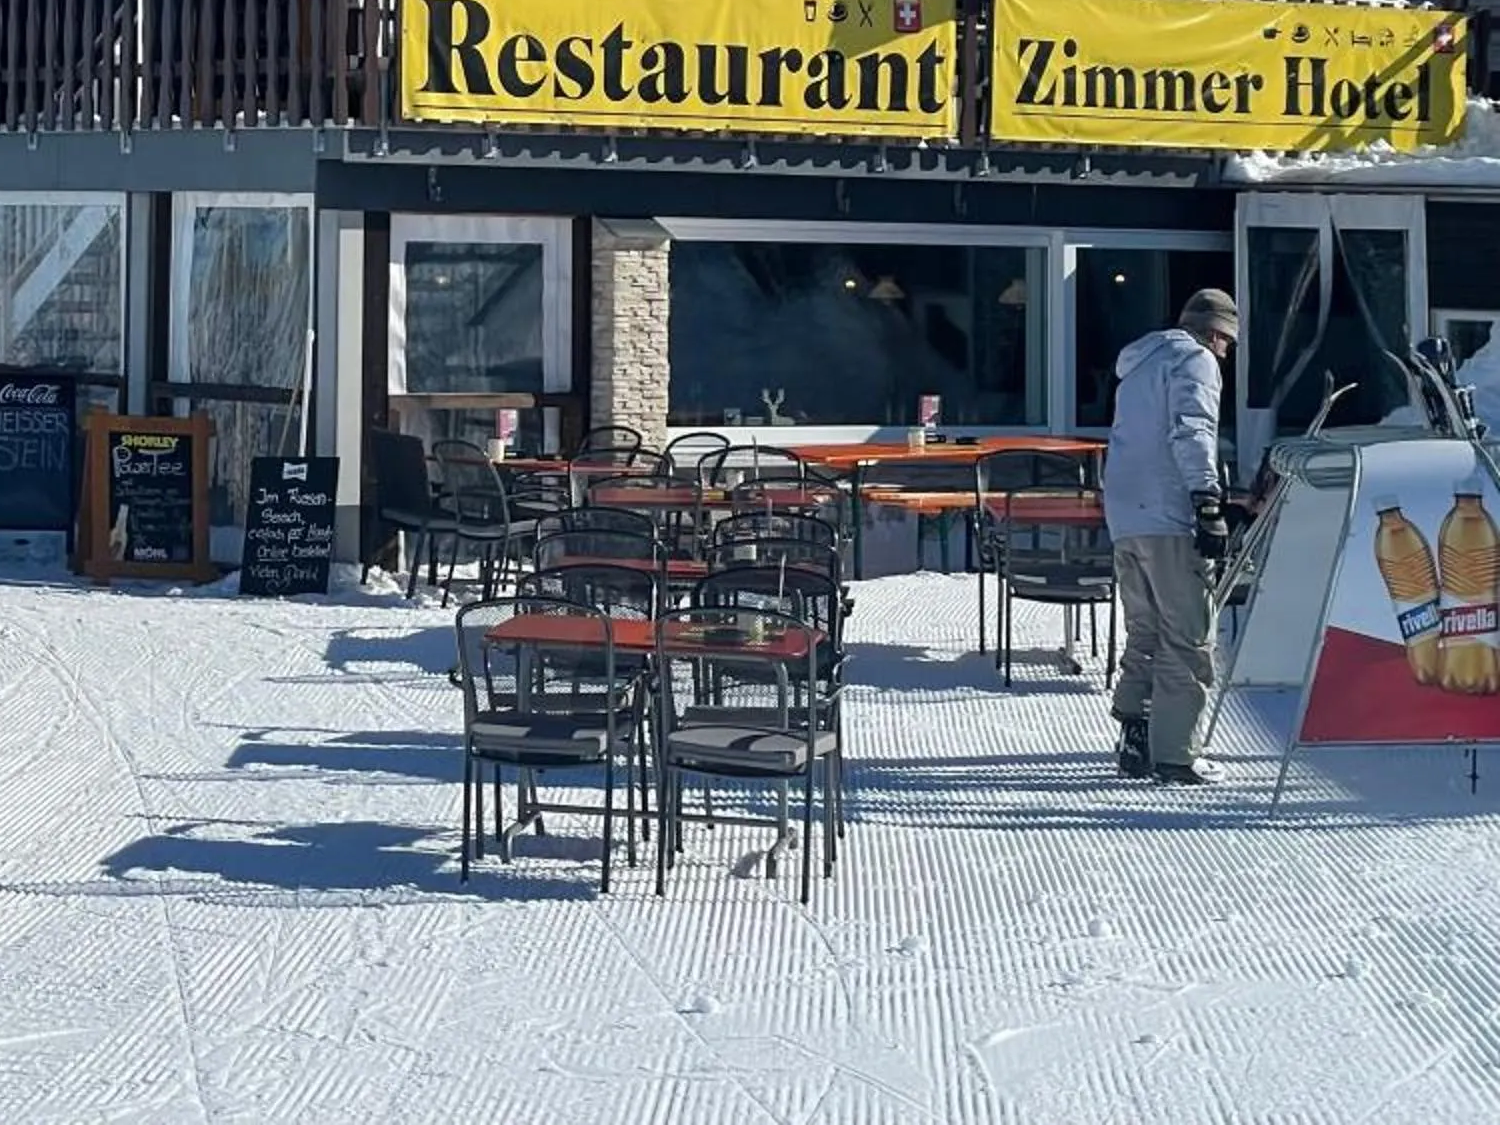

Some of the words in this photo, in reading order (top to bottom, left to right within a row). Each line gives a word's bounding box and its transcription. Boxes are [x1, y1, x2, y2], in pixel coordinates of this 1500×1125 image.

[1015, 37, 1263, 114] Zimmer
[1282, 57, 1431, 122] Hotel
[1402, 603, 1438, 635] rivell
[1444, 608, 1497, 634] rivella
